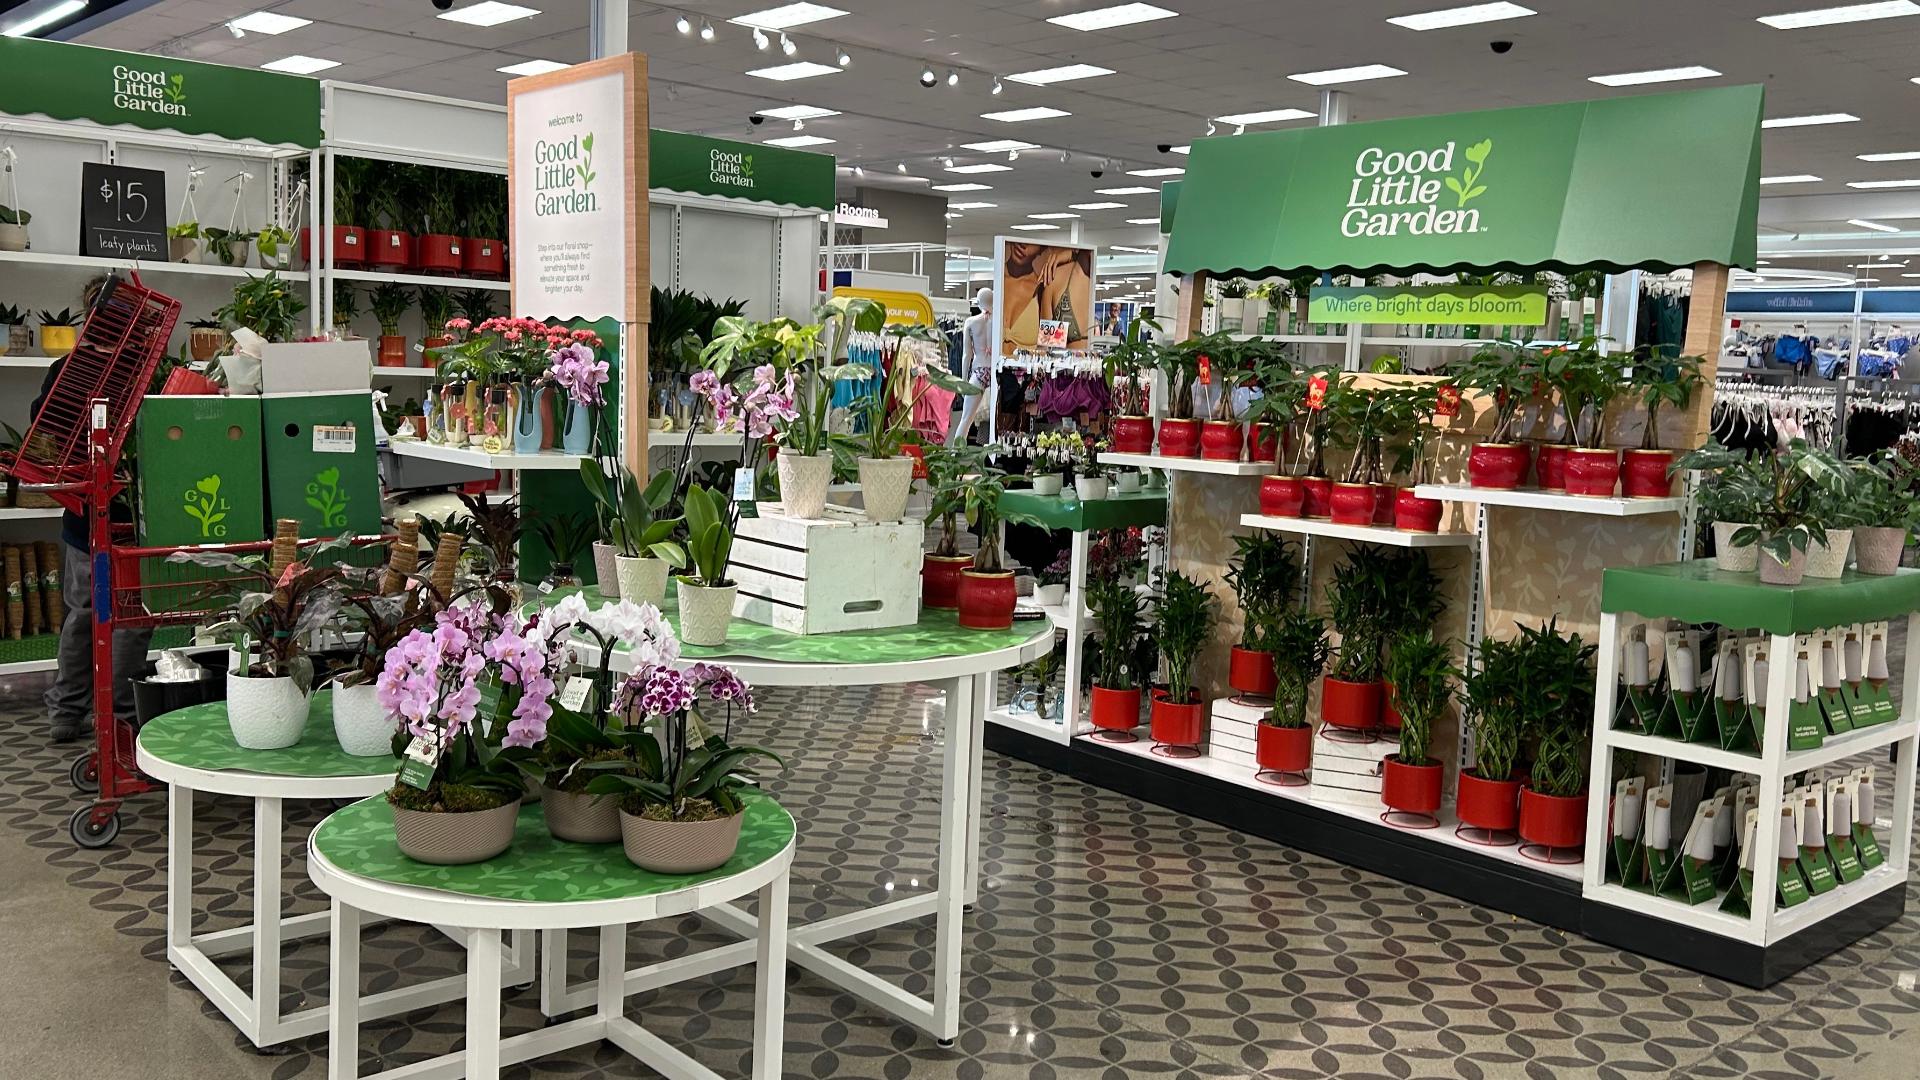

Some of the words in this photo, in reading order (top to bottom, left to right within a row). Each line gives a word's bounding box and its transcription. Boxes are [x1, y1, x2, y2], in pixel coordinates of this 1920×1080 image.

[113, 65, 166, 86] Good
[114, 79, 163, 99] Little
[114, 94, 187, 117] Garden
[548, 115, 575, 127] welcome
[576, 113, 583, 122] to
[535, 134, 578, 165] Good
[710, 149, 742, 164] Good
[1355, 141, 1456, 177] Good
[536, 163, 575, 191] Little
[710, 160, 741, 175] Little
[710, 171, 754, 188] Garden
[100, 178, 148, 223] $15
[1346, 175, 1441, 208] Little
[535, 188, 597, 217] Garden
[840, 202, 879, 219] Rooms
[1340, 205, 1481, 238] Garden
[99, 233, 124, 255] leafy
[127, 238, 157, 255] plants
[904, 309, 919, 320] way
[1326, 298, 1372, 313] Where
[1376, 296, 1422, 316] bright
[1426, 297, 1464, 316] days
[1469, 297, 1527, 313] bloom.
[1041, 324, 1055, 336] $30
[184, 489, 198, 502] G
[220, 497, 231, 510] L
[213, 524, 227, 537] G
